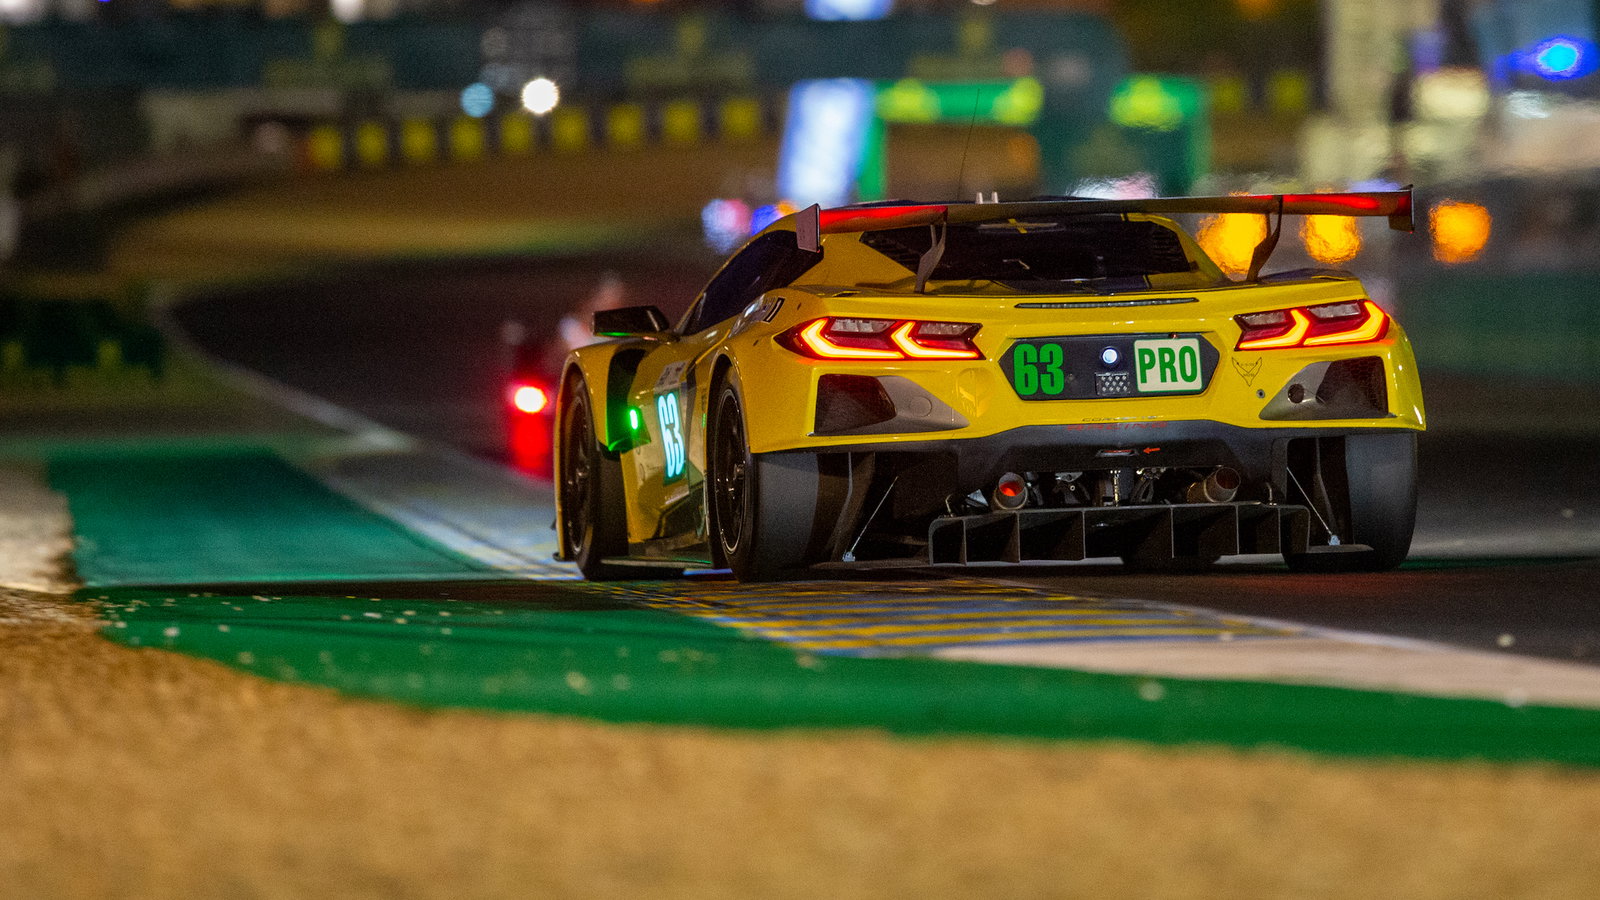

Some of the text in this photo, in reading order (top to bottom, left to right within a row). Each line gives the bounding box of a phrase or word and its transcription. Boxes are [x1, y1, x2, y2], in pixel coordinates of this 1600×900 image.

[1013, 343, 1065, 396] 63
[1138, 345, 1198, 384] PRO
[657, 392, 685, 478] 63
